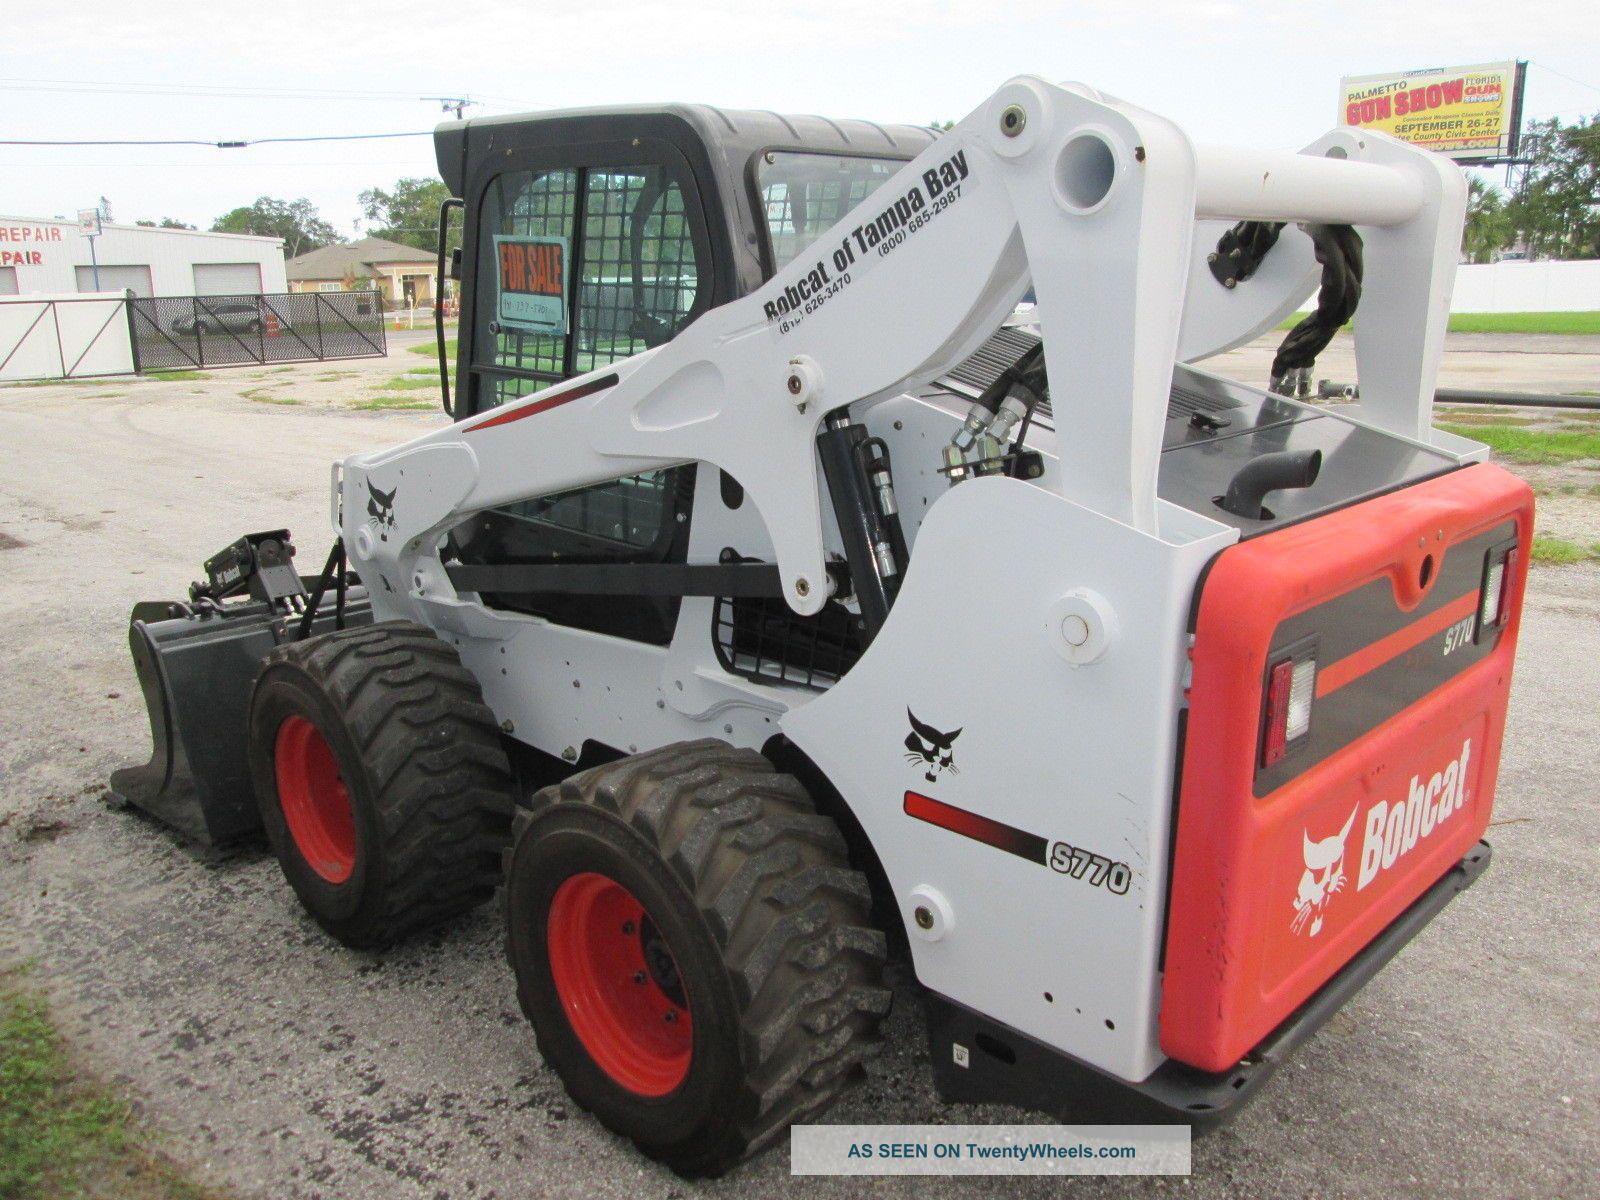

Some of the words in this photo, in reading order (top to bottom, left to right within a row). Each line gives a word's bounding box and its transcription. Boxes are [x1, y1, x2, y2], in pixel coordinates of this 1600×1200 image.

[1346, 95, 1392, 126] GUN
[1394, 78, 1464, 116] SHOW
[1348, 81, 1407, 102] PALMETTO
[1464, 84, 1501, 96] GUN
[1394, 120, 1463, 134] SEPTEMBER
[1466, 117, 1500, 129] 26-27
[1413, 131, 1442, 141] County
[1446, 130, 1467, 138] Civic
[1469, 128, 1500, 137] Center
[0, 227, 61, 242] REPAIR
[763, 261, 831, 322] Bobcat
[832, 237, 856, 272] of
[851, 186, 926, 255] Tampa
[921, 149, 970, 200] Bay
[878, 229, 907, 257] (800)
[908, 184, 962, 234] 685-2987
[0, 250, 42, 265] PAIR
[500, 244, 526, 290] FOR
[527, 244, 562, 294] SALE
[805, 272, 852, 315] 626-3470
[1443, 614, 1475, 656] S770
[1356, 738, 1471, 892] Bobcat
[1050, 841, 1132, 896] S770
